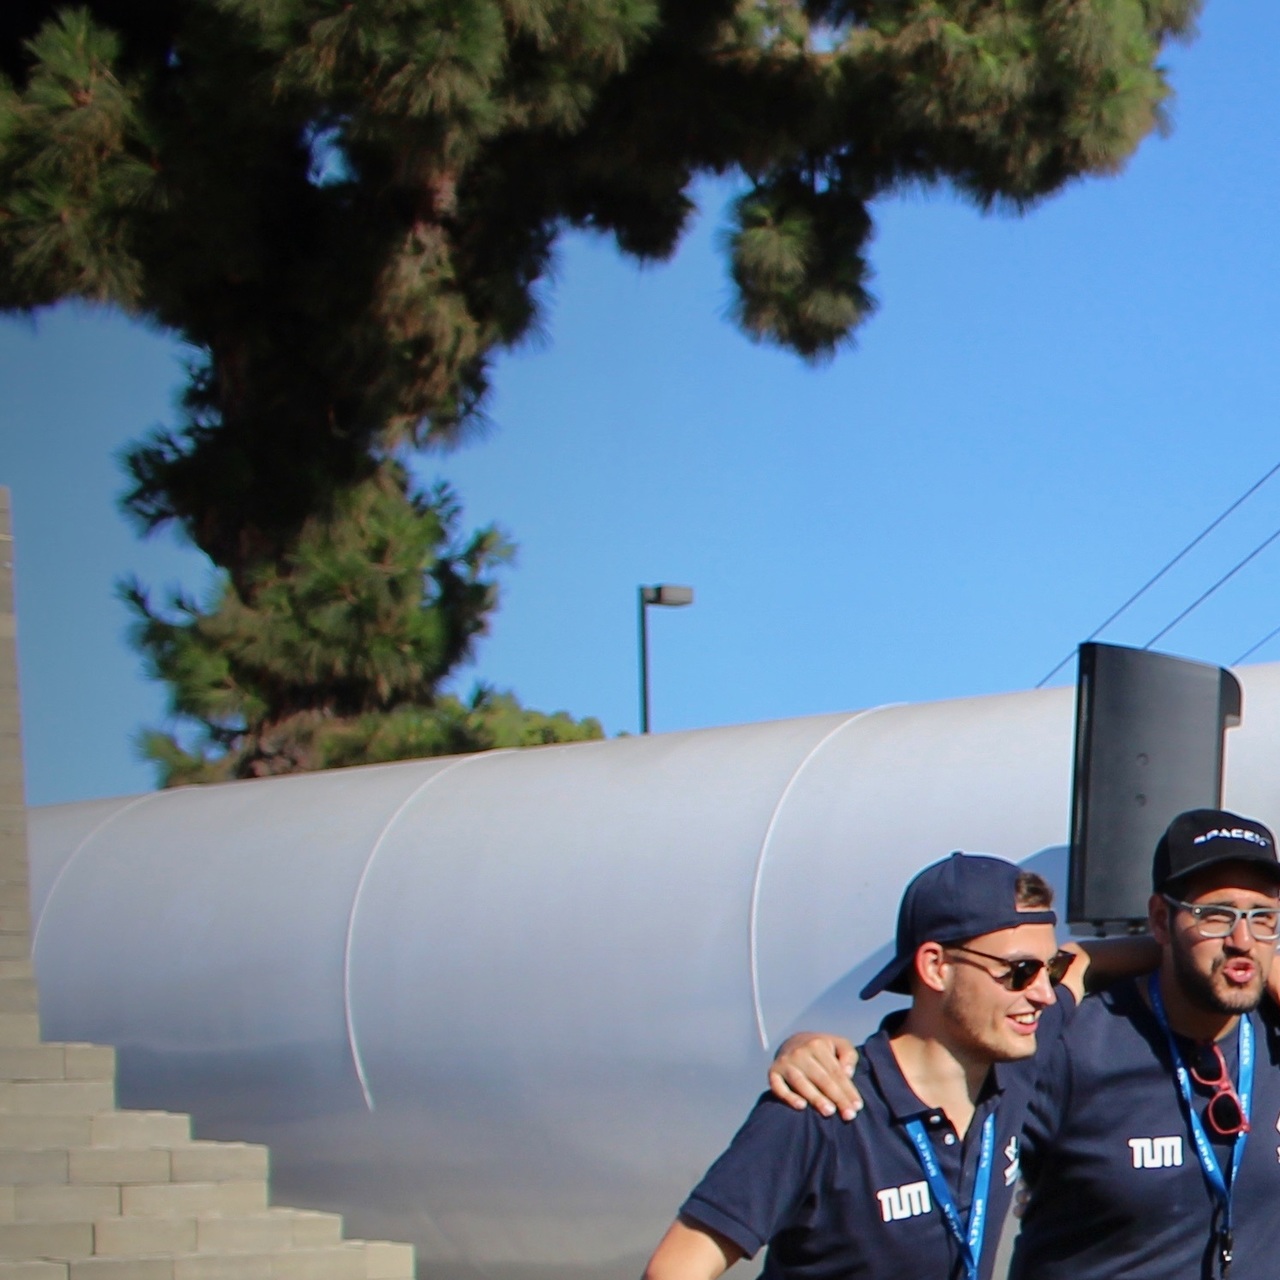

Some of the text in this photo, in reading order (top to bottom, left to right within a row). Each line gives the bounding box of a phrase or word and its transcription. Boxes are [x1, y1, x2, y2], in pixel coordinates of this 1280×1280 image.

[1194, 828, 1271, 846] SPACEX
[1128, 1136, 1183, 1169] TUM
[877, 1180, 931, 1223] TUM
